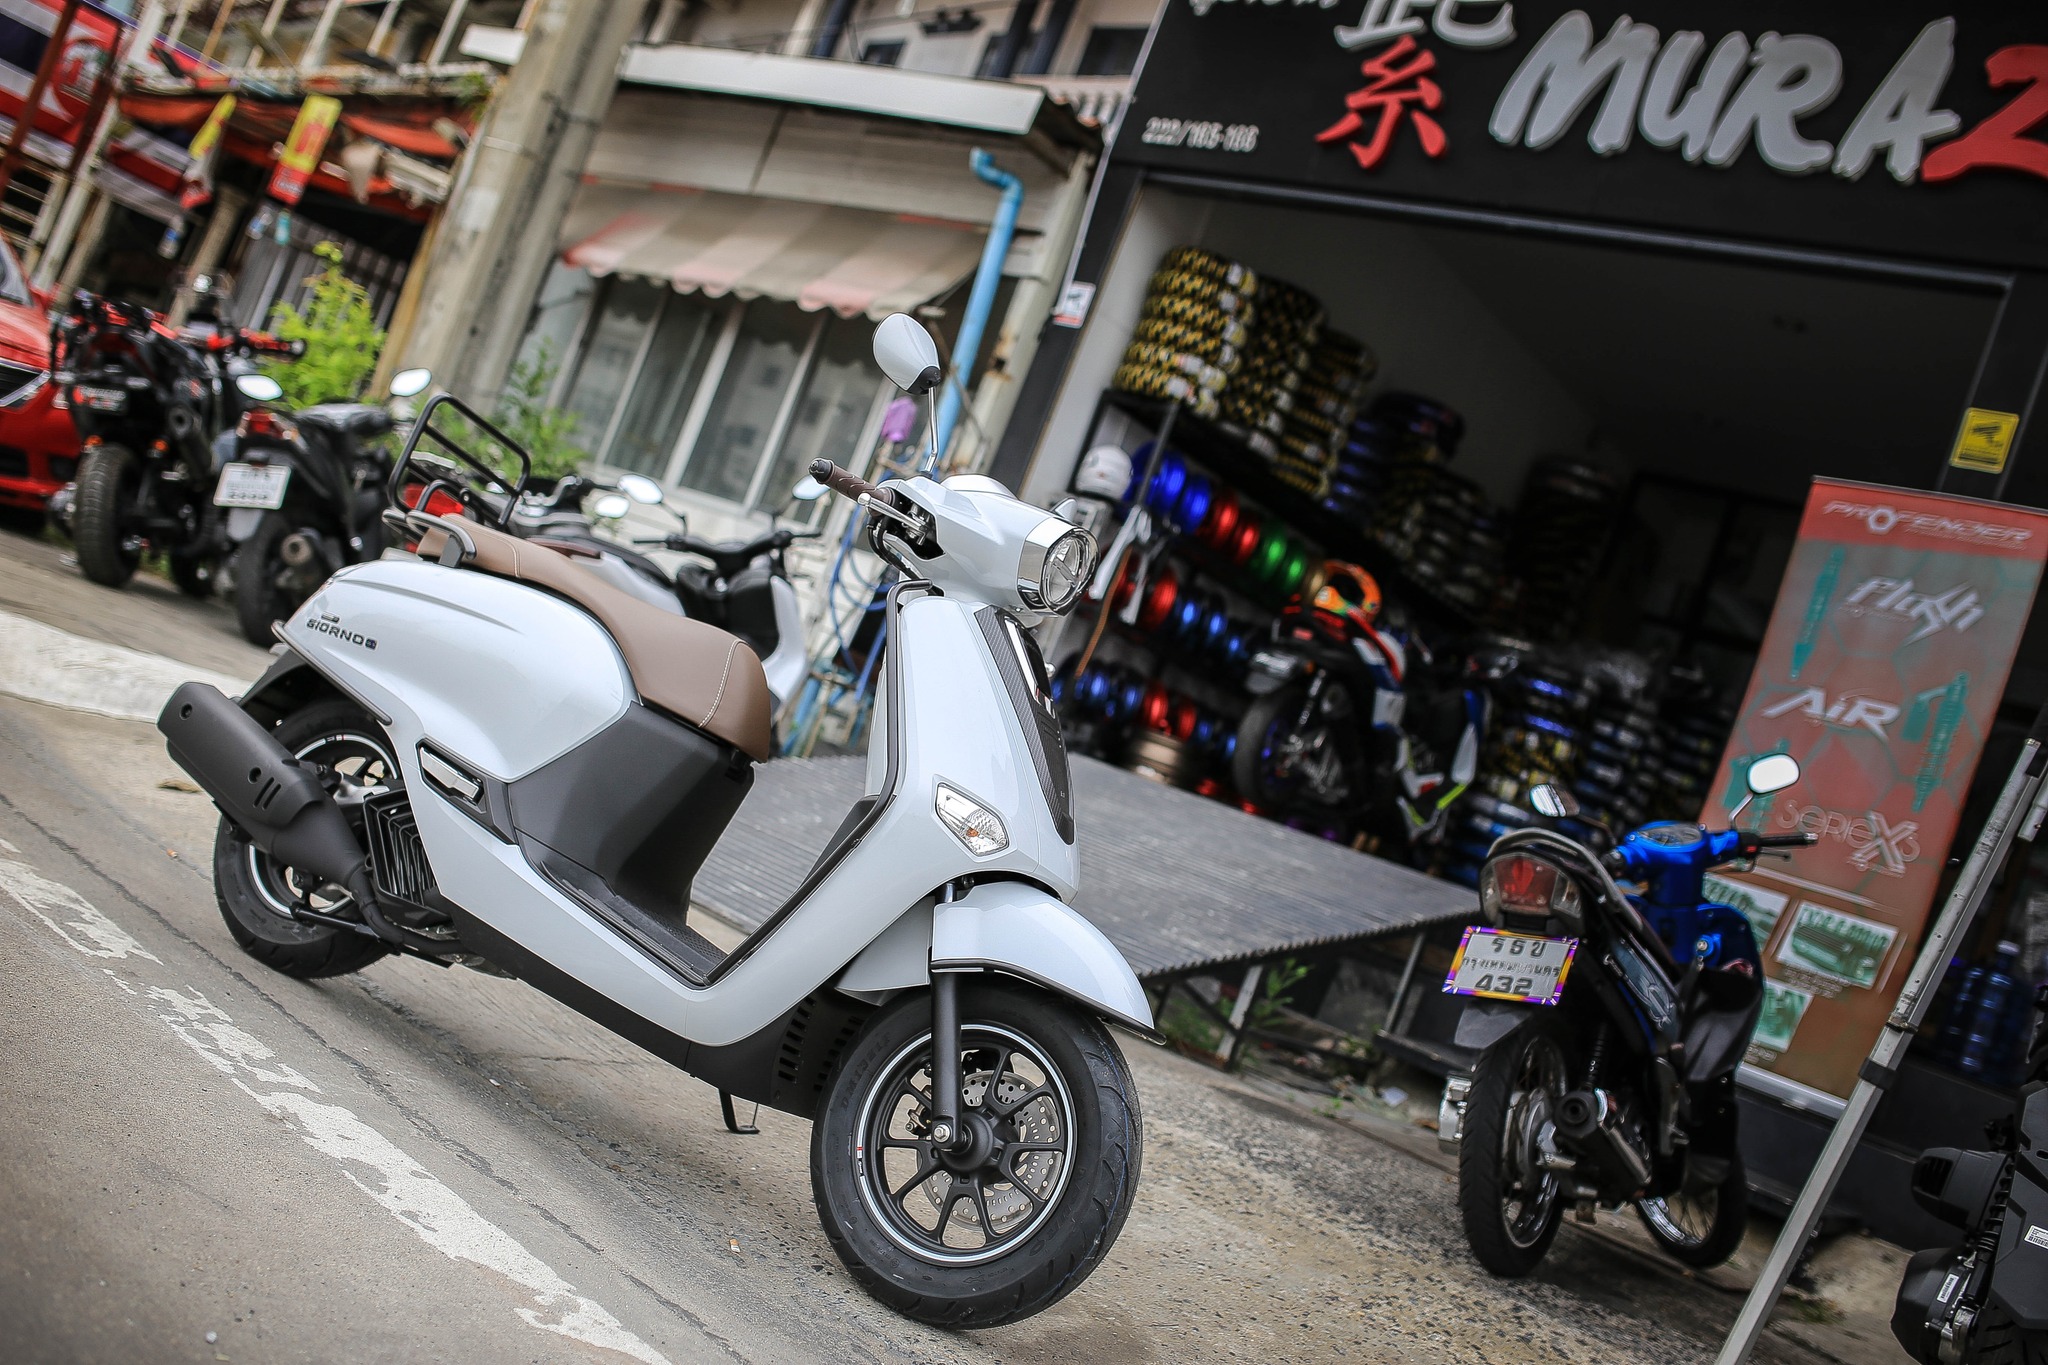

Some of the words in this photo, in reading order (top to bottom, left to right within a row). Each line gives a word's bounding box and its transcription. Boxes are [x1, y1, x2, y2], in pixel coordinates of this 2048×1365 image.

[1822, 500, 2033, 545] PROFENDER
[306, 618, 364, 646] GIORNO
[1474, 973, 1533, 997] 432
